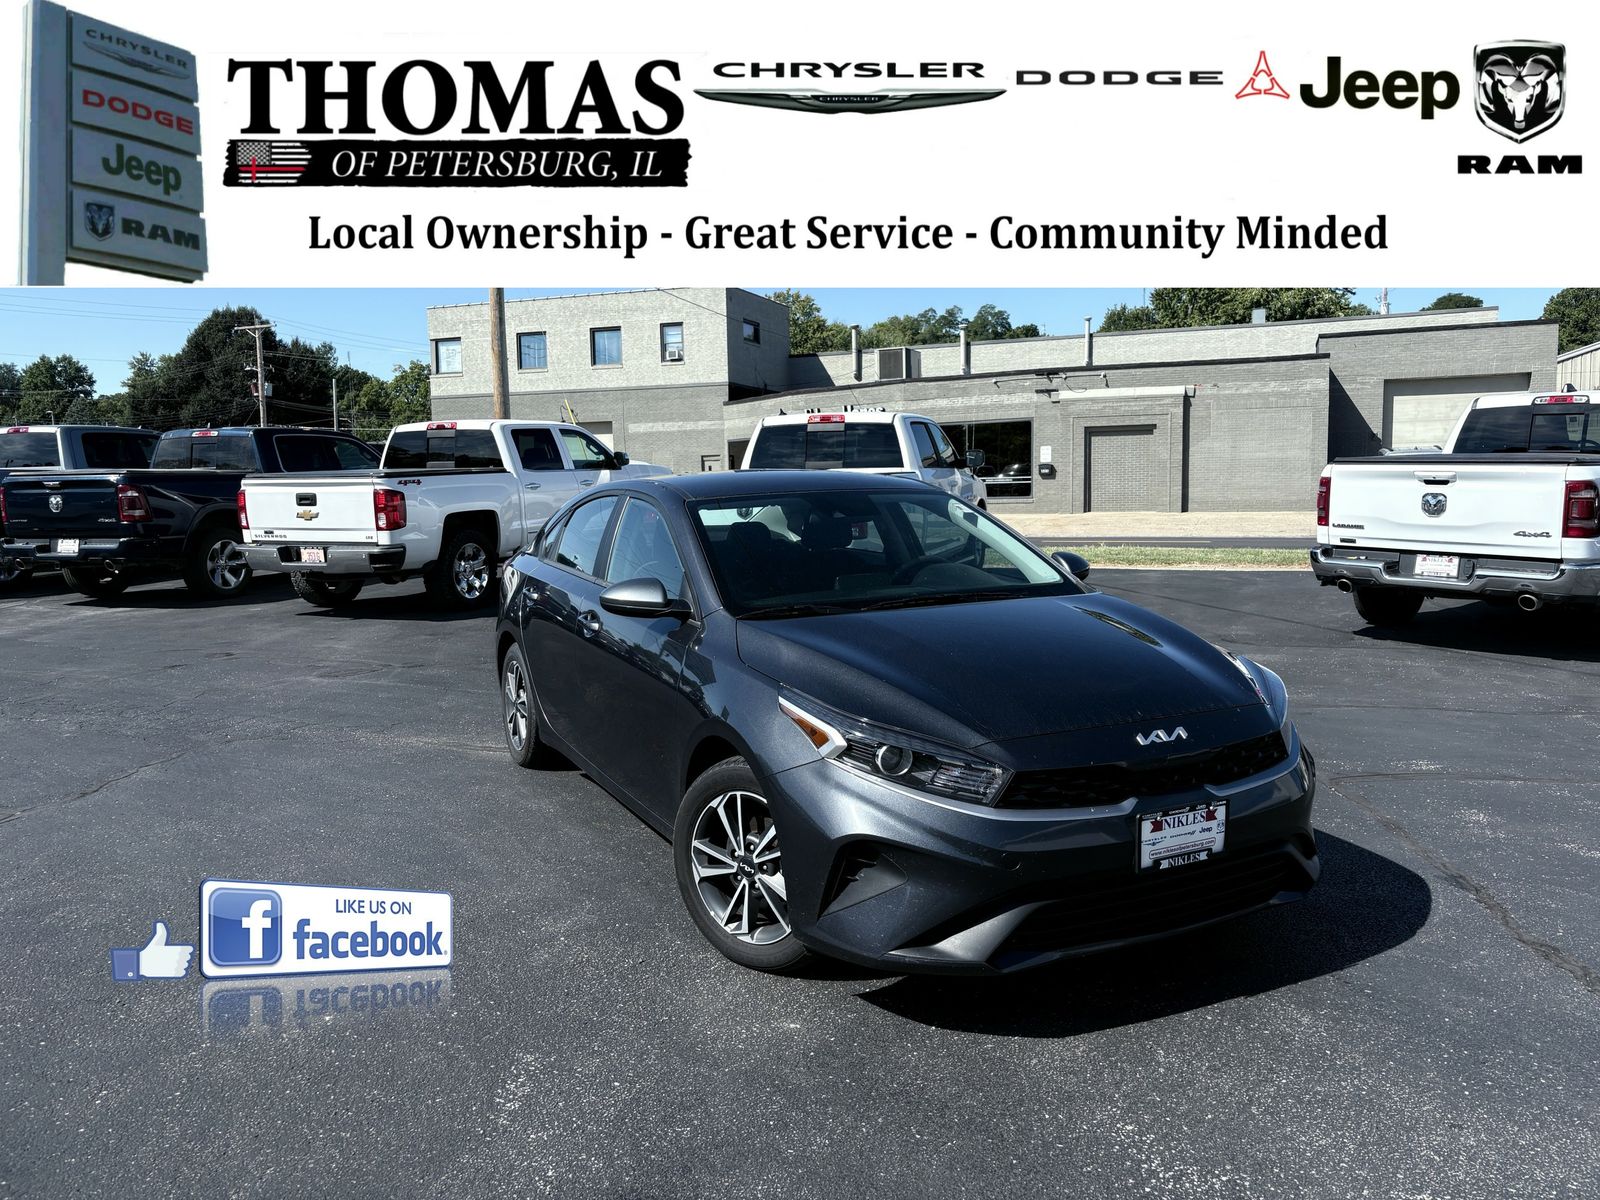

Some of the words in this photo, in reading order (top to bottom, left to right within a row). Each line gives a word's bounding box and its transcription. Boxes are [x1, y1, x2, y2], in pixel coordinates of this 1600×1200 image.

[1163, 810, 1206, 831] NIKLES
[1199, 826, 1213, 834] Jeep
[1168, 852, 1201, 867] NIKLES
